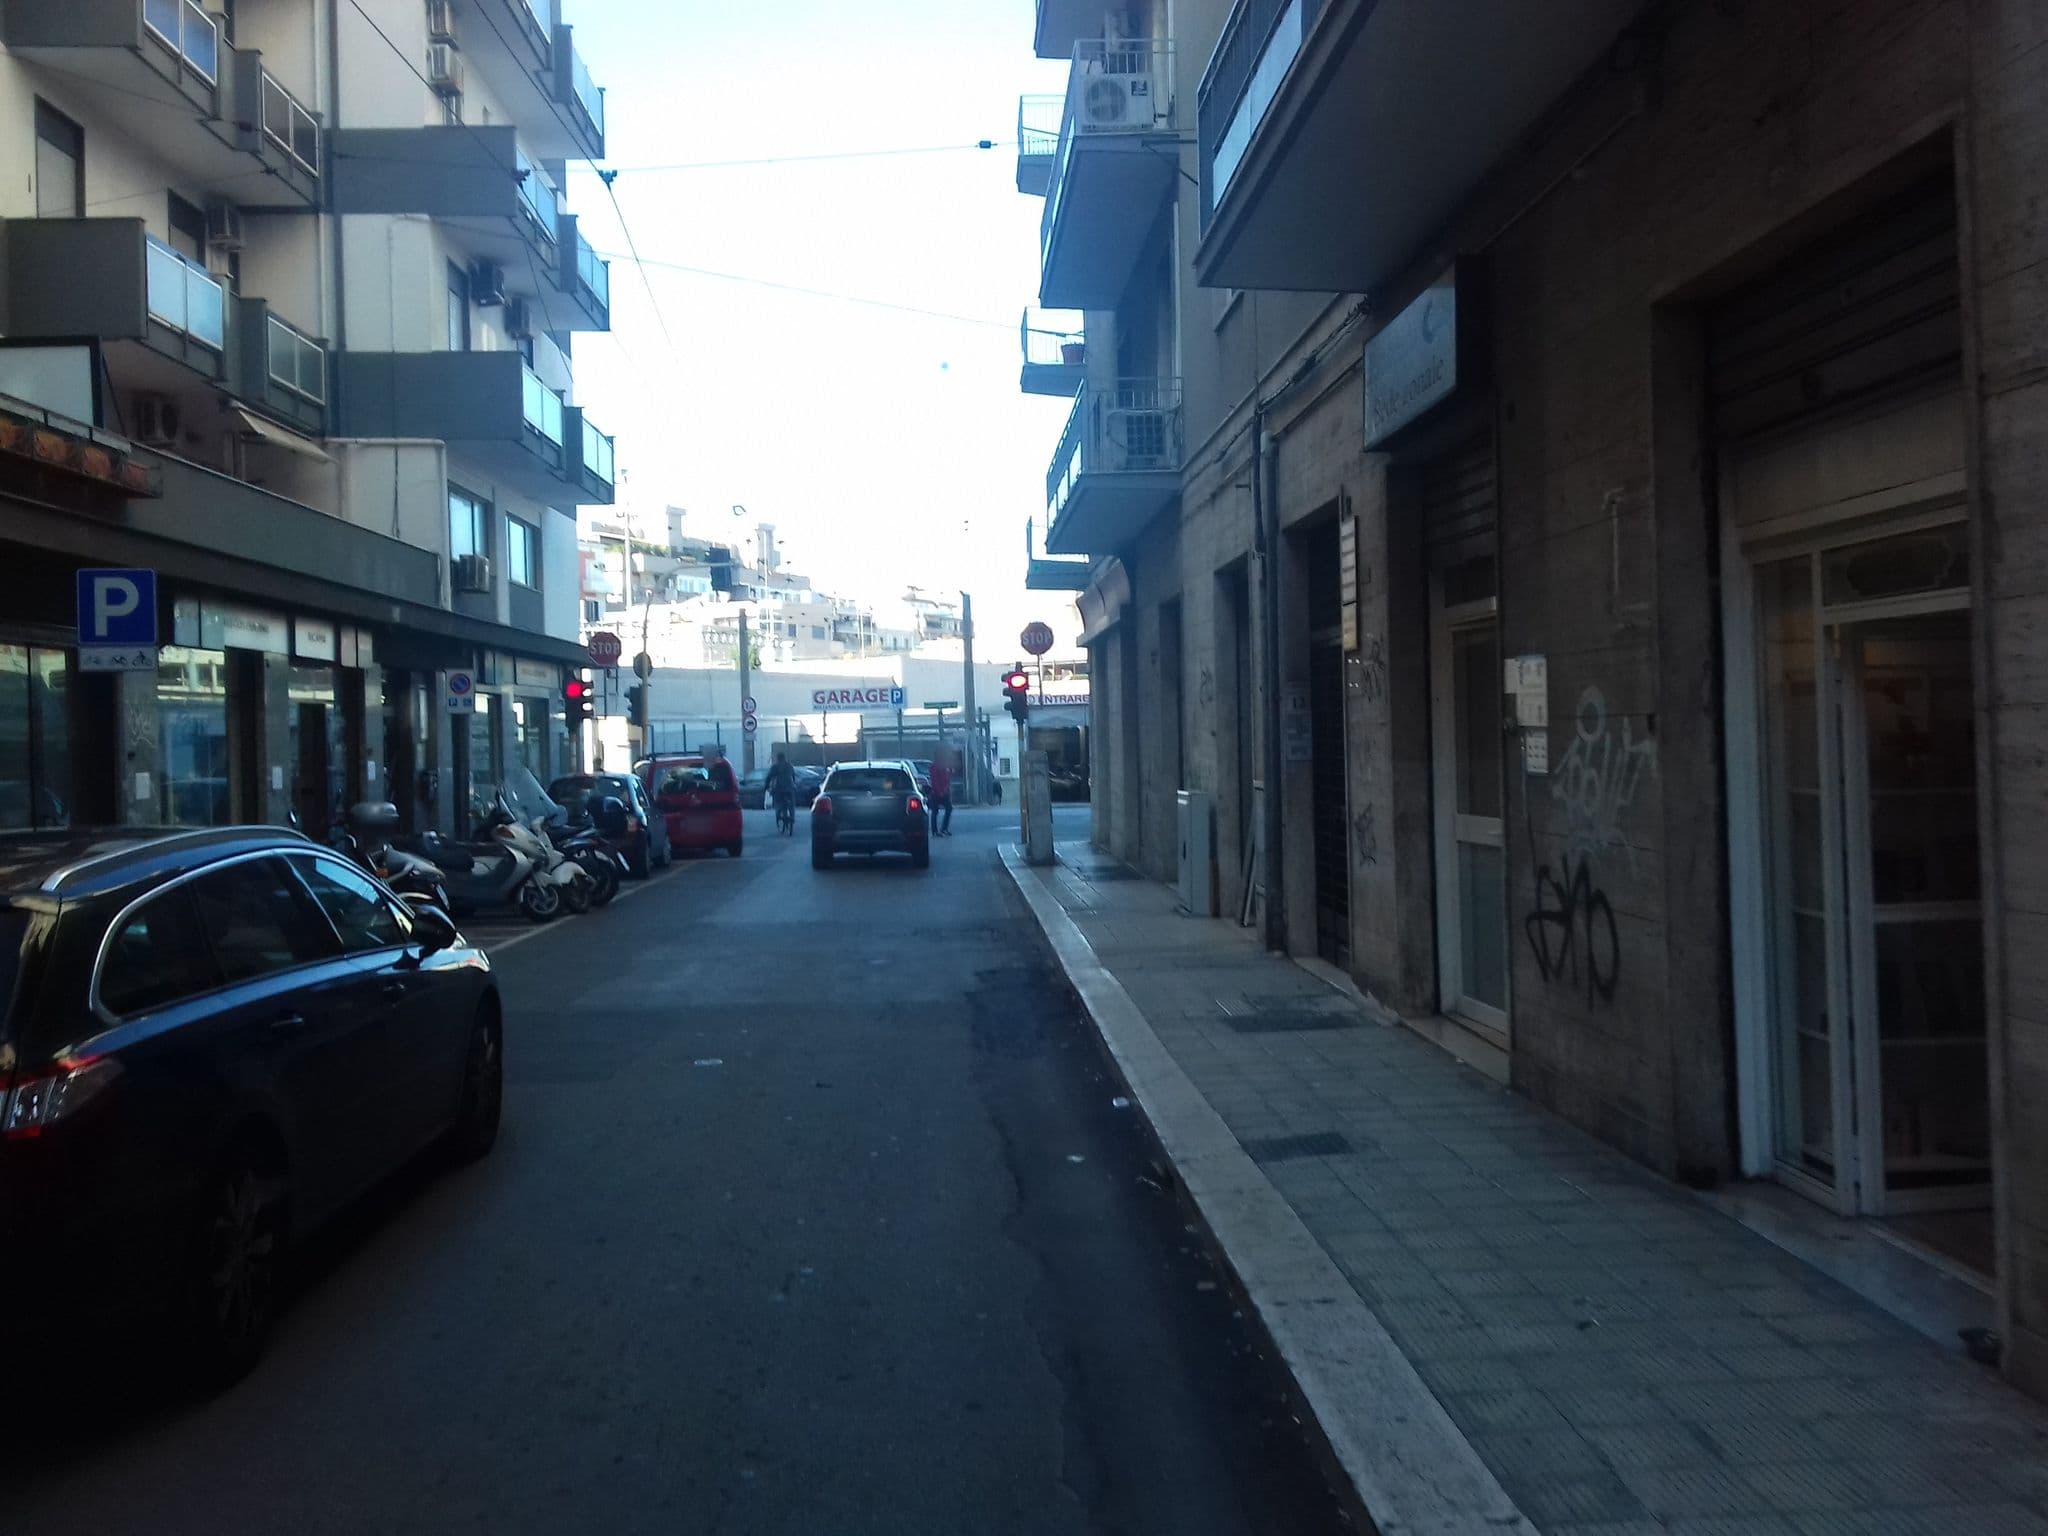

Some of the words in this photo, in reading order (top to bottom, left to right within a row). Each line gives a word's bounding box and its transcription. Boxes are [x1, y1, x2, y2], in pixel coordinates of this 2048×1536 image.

[94, 577, 140, 637] P
[1023, 632, 1051, 645] STOP
[591, 641, 620, 655] STOP
[814, 688, 889, 704] GARAGE
[892, 689, 902, 703] P
